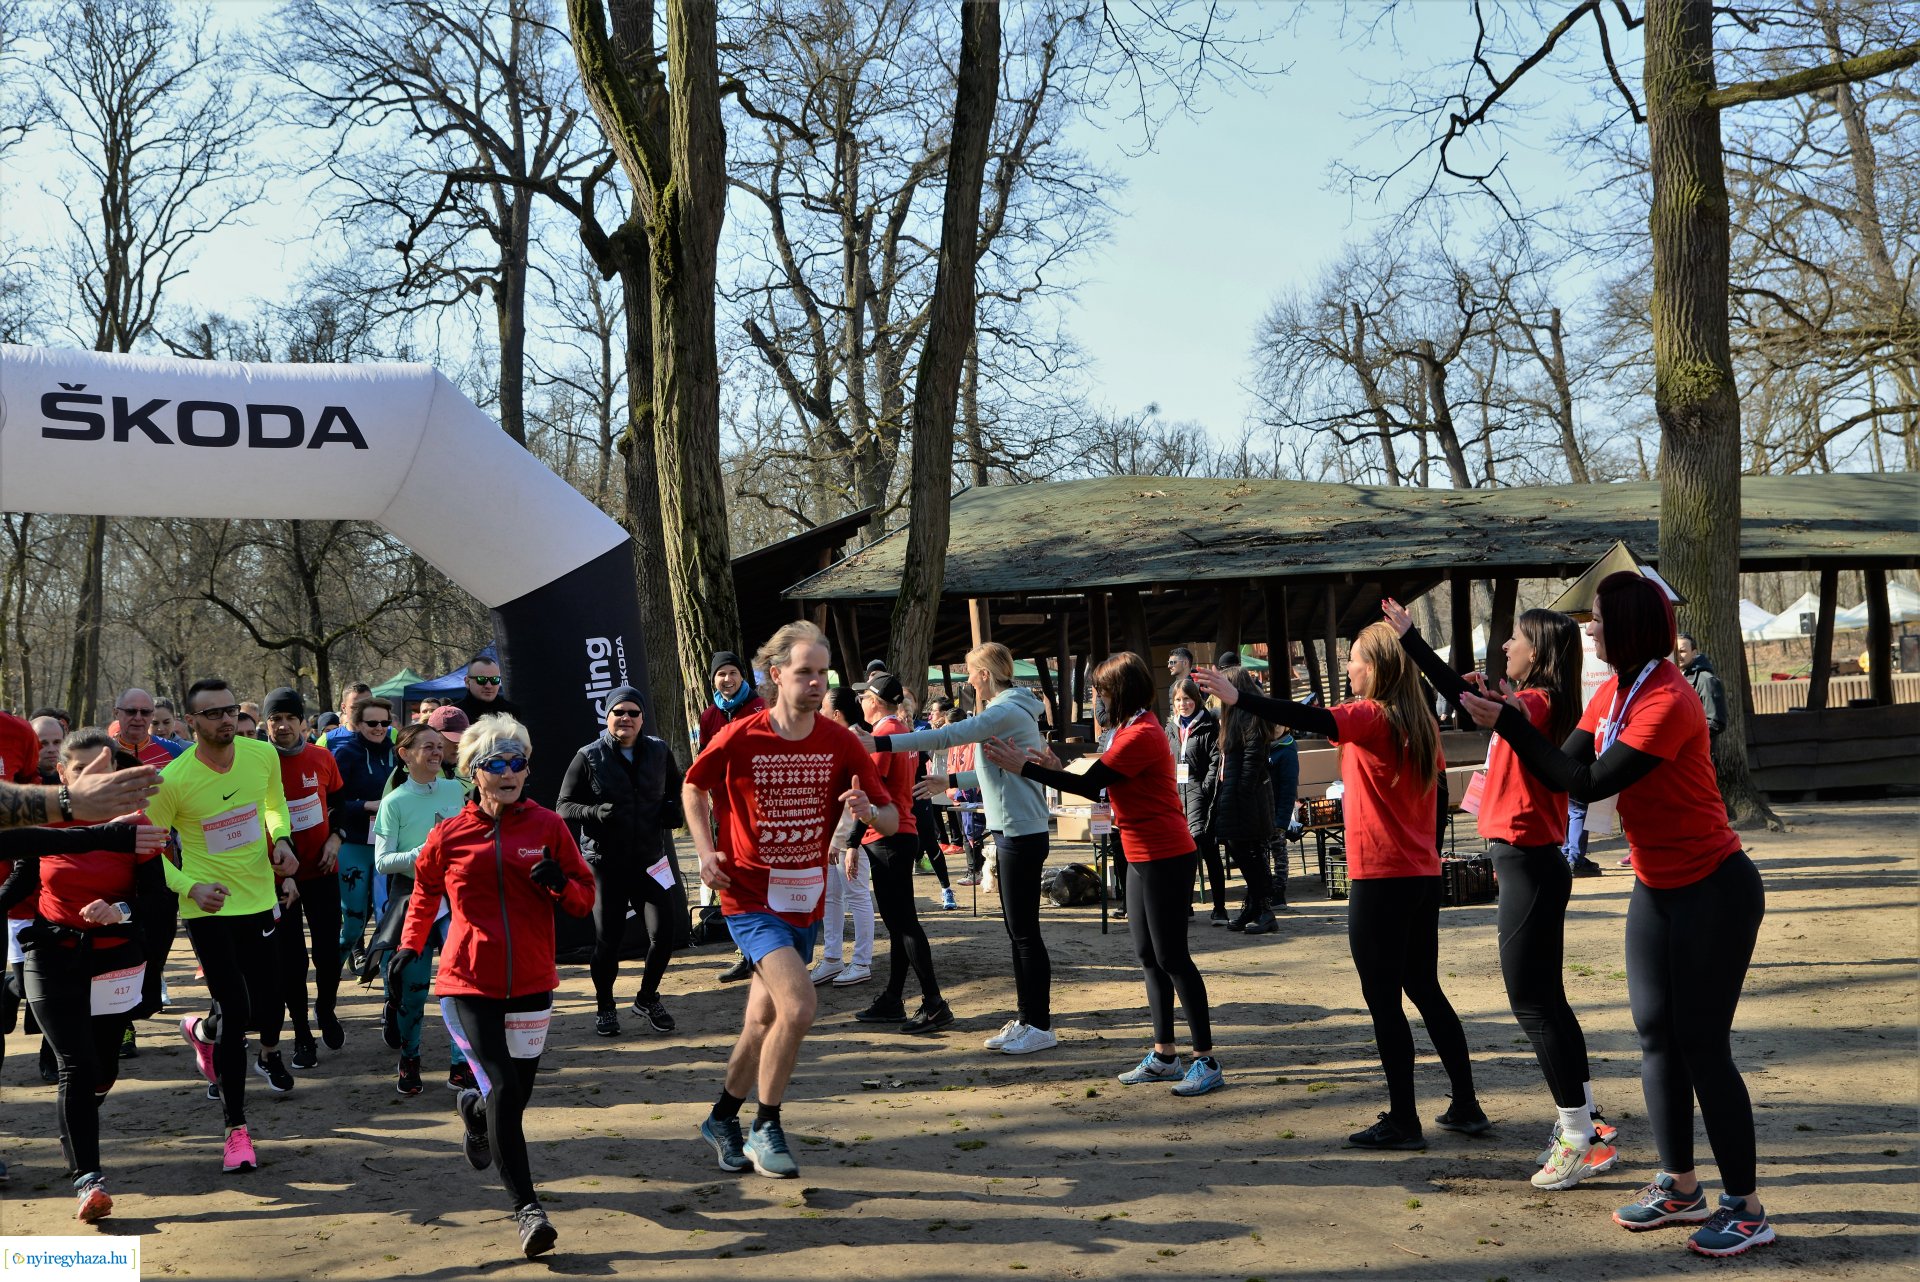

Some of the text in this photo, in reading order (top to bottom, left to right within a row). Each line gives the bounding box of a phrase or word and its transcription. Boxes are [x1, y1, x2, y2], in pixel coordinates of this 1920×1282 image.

[40, 382, 369, 450] ŠKODA
[782, 787, 816, 796] SZEGEDI
[768, 806, 817, 818] FÉLMARATON
[227, 830, 242, 840] 108
[791, 893, 807, 902] 100
[114, 985, 131, 996] 417
